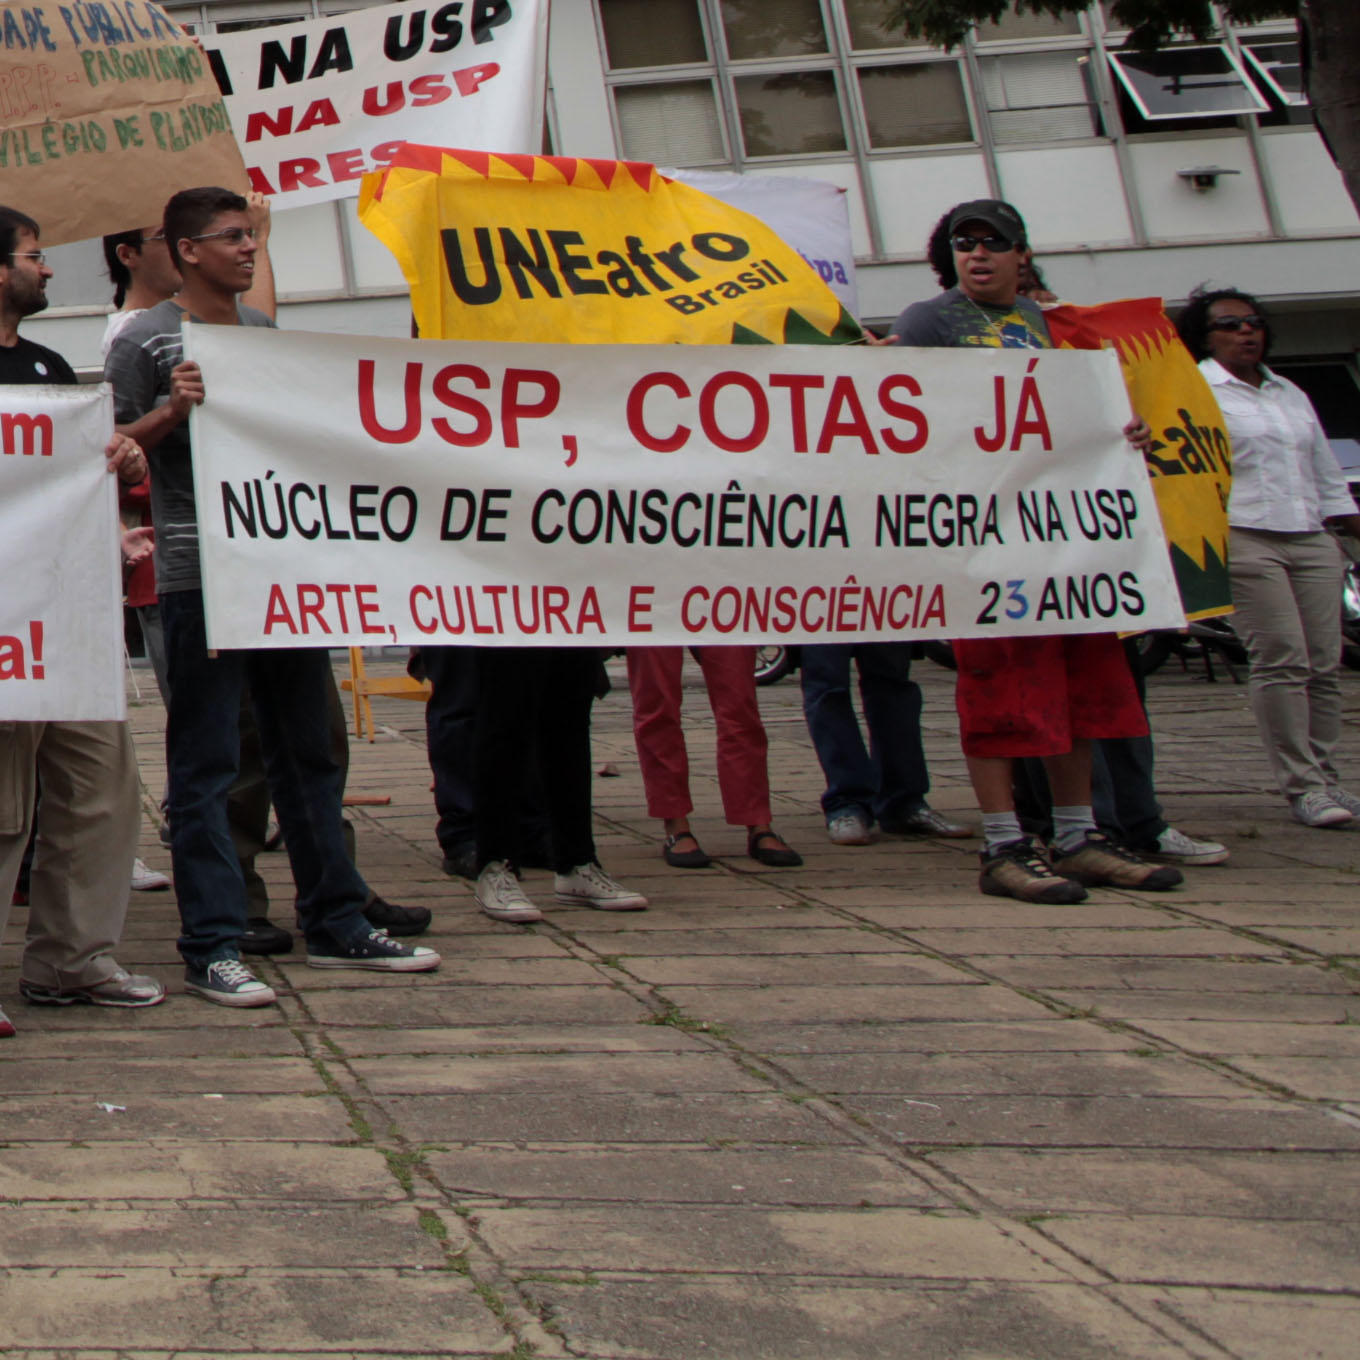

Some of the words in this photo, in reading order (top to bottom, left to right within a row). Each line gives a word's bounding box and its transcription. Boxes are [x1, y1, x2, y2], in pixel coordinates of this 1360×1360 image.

[258, 27, 353, 90] NA
[113, 114, 144, 150] DE
[245, 97, 341, 143] NA
[362, 62, 501, 117] USP
[440, 227, 750, 305] UNEafro
[664, 259, 789, 315] Brasil
[358, 359, 578, 468] USP,
[626, 371, 930, 455] COTAS
[974, 357, 1053, 452] JÁ
[220, 470, 418, 543] NÚCLEO
[440, 488, 512, 542] DE
[531, 480, 850, 548] CONSCIÊNCIA
[876, 493, 1004, 547] NEGRA
[1017, 488, 1068, 542] NA
[1071, 488, 1138, 541] USP
[263, 583, 397, 643] ARTE,
[409, 584, 606, 635] CULTURA
[628, 586, 655, 633] E
[681, 574, 947, 633] CONSCIÊNCIA
[976, 579, 1030, 625] 23
[1036, 570, 1146, 622] ANOS
